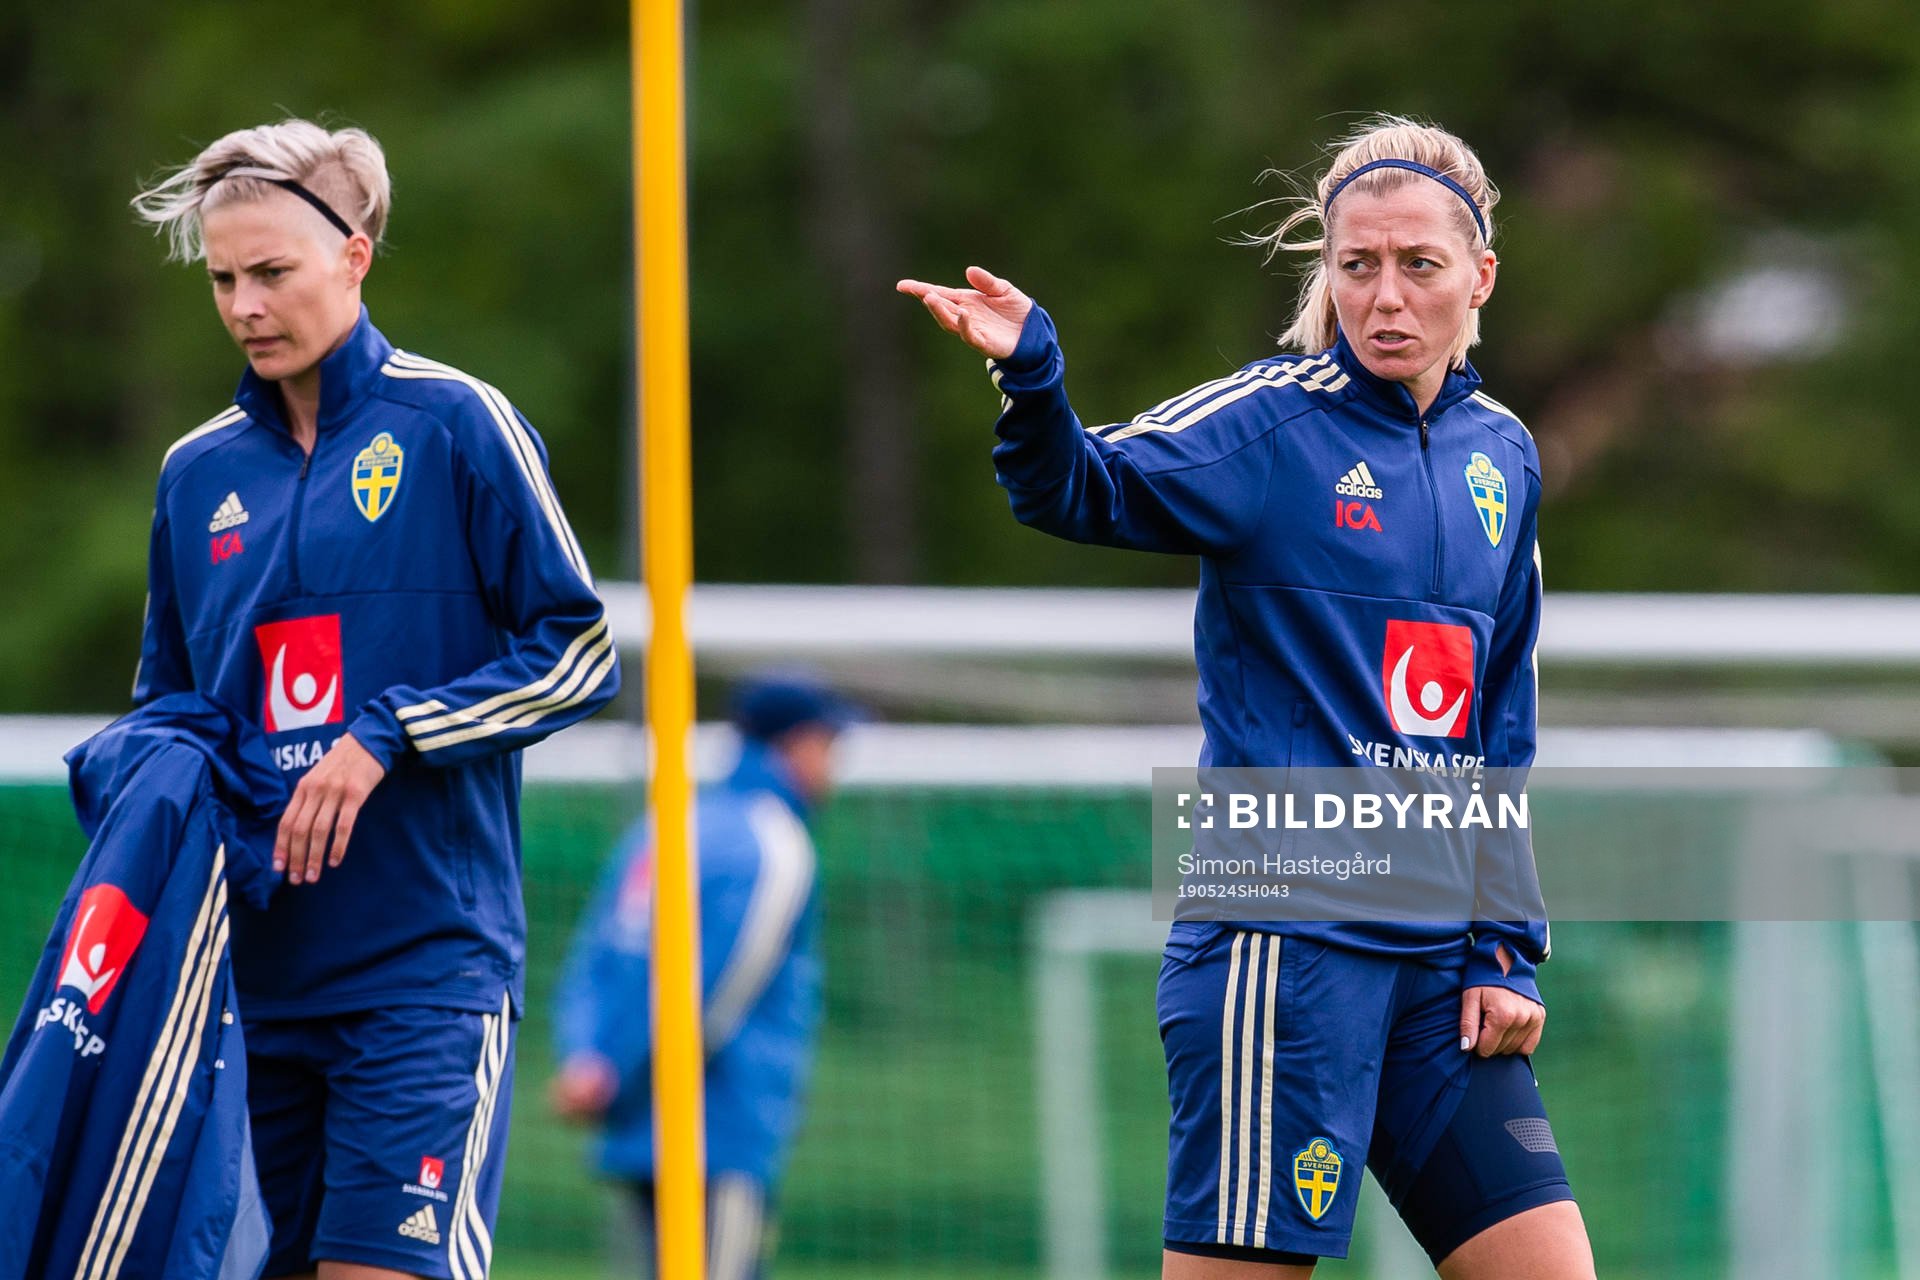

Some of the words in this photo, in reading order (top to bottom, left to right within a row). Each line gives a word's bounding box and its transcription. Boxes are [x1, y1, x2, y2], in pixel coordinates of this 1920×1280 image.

[1335, 481, 1383, 500] adidas
[208, 510, 249, 533] adidas
[1336, 500, 1383, 533] ICA
[210, 531, 244, 565] ICA
